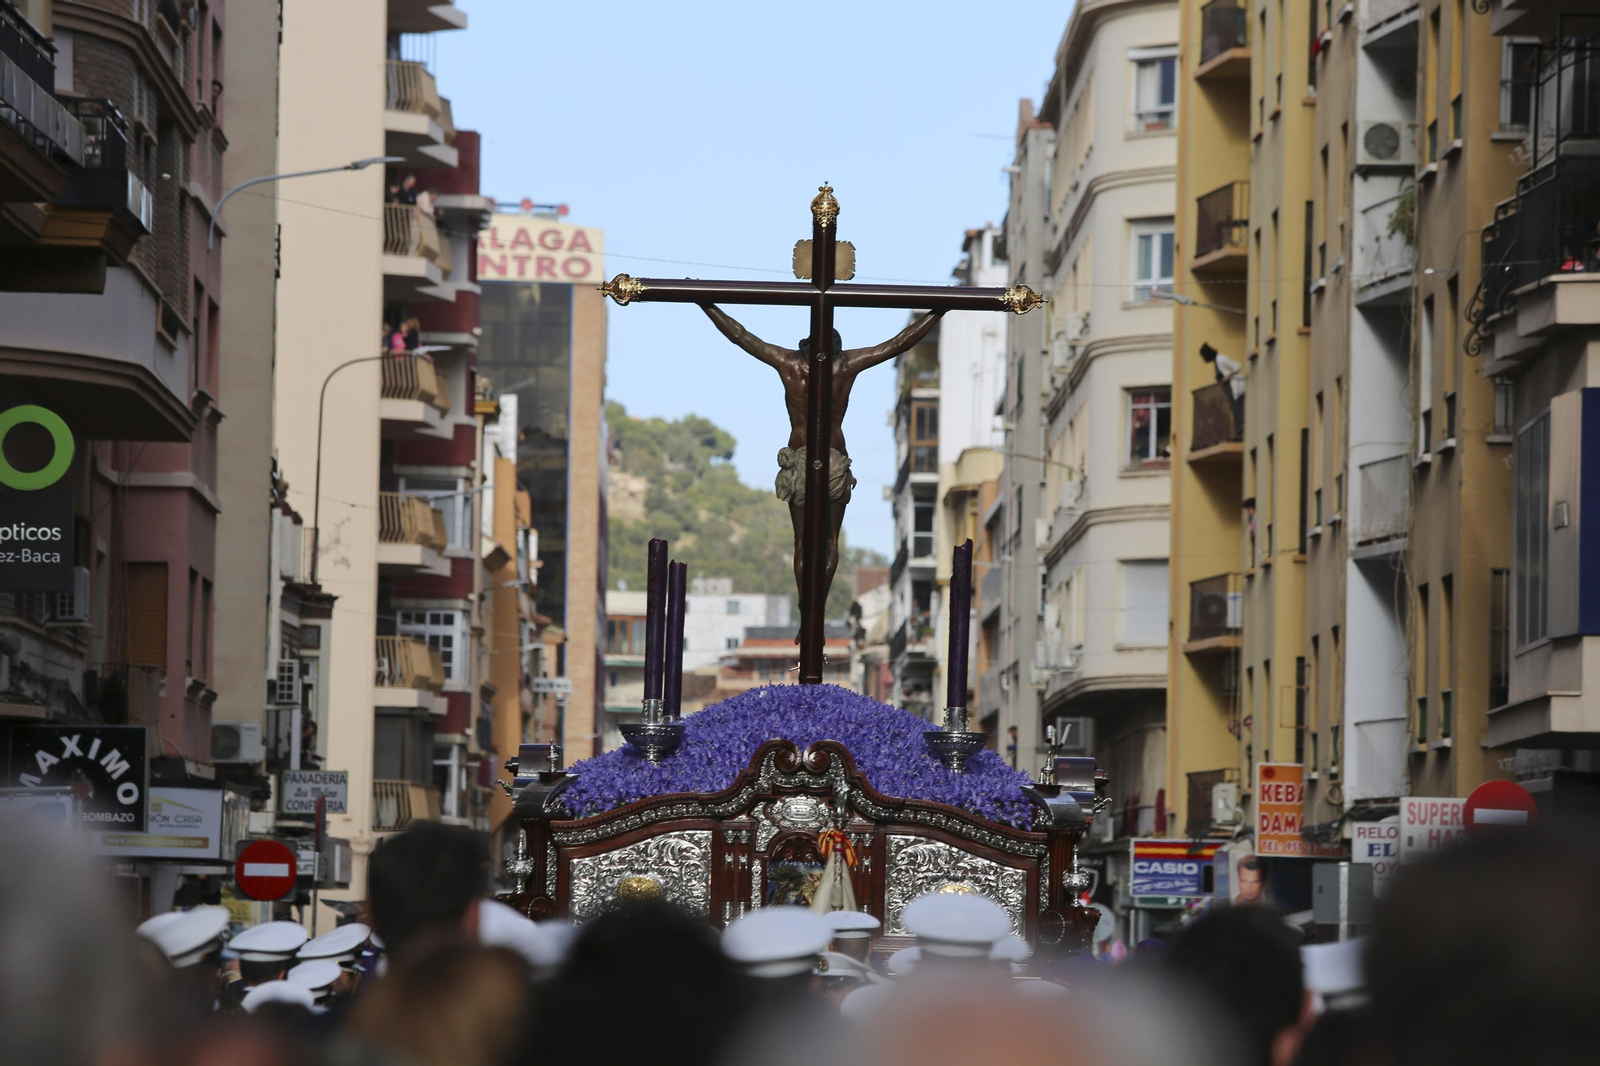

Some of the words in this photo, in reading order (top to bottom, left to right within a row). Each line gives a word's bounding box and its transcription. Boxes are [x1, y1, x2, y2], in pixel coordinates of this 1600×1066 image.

[285, 773, 346, 785] PANADERIA
[174, 814, 203, 824] CASA
[1367, 843, 1397, 857] EL
[1134, 861, 1199, 875] CASIO
